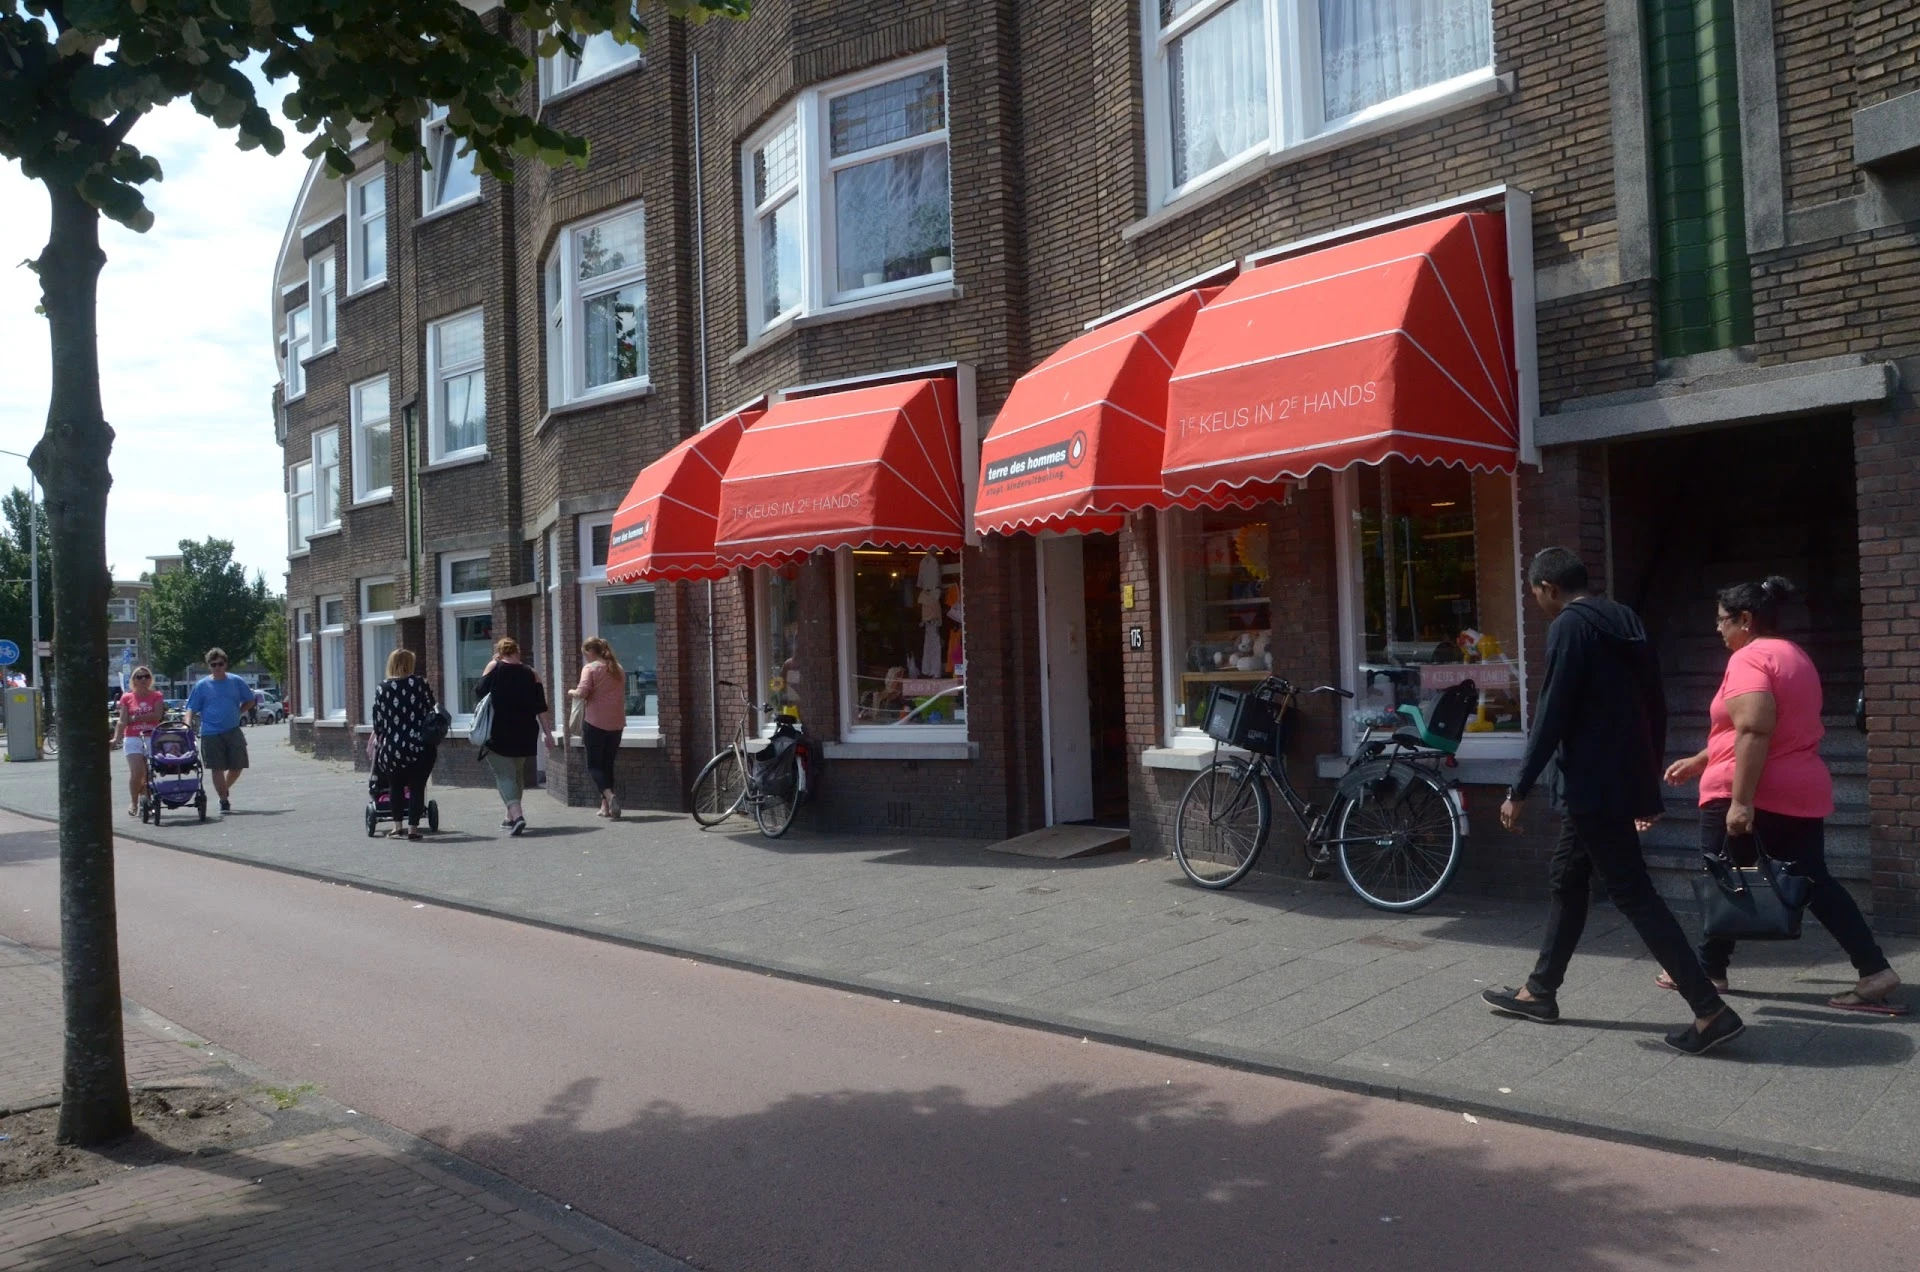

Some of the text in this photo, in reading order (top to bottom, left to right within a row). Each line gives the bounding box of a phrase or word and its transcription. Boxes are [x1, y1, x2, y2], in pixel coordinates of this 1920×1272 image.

[1199, 407, 1249, 434] KEUS
[1254, 402, 1274, 424] IN
[1303, 381, 1376, 414] HANDS
[988, 449, 1067, 481] terre des hommes
[745, 502, 779, 519] KEUS
[781, 501, 795, 515] IN
[813, 492, 860, 511] HANDS
[1130, 628, 1142, 648] 175
